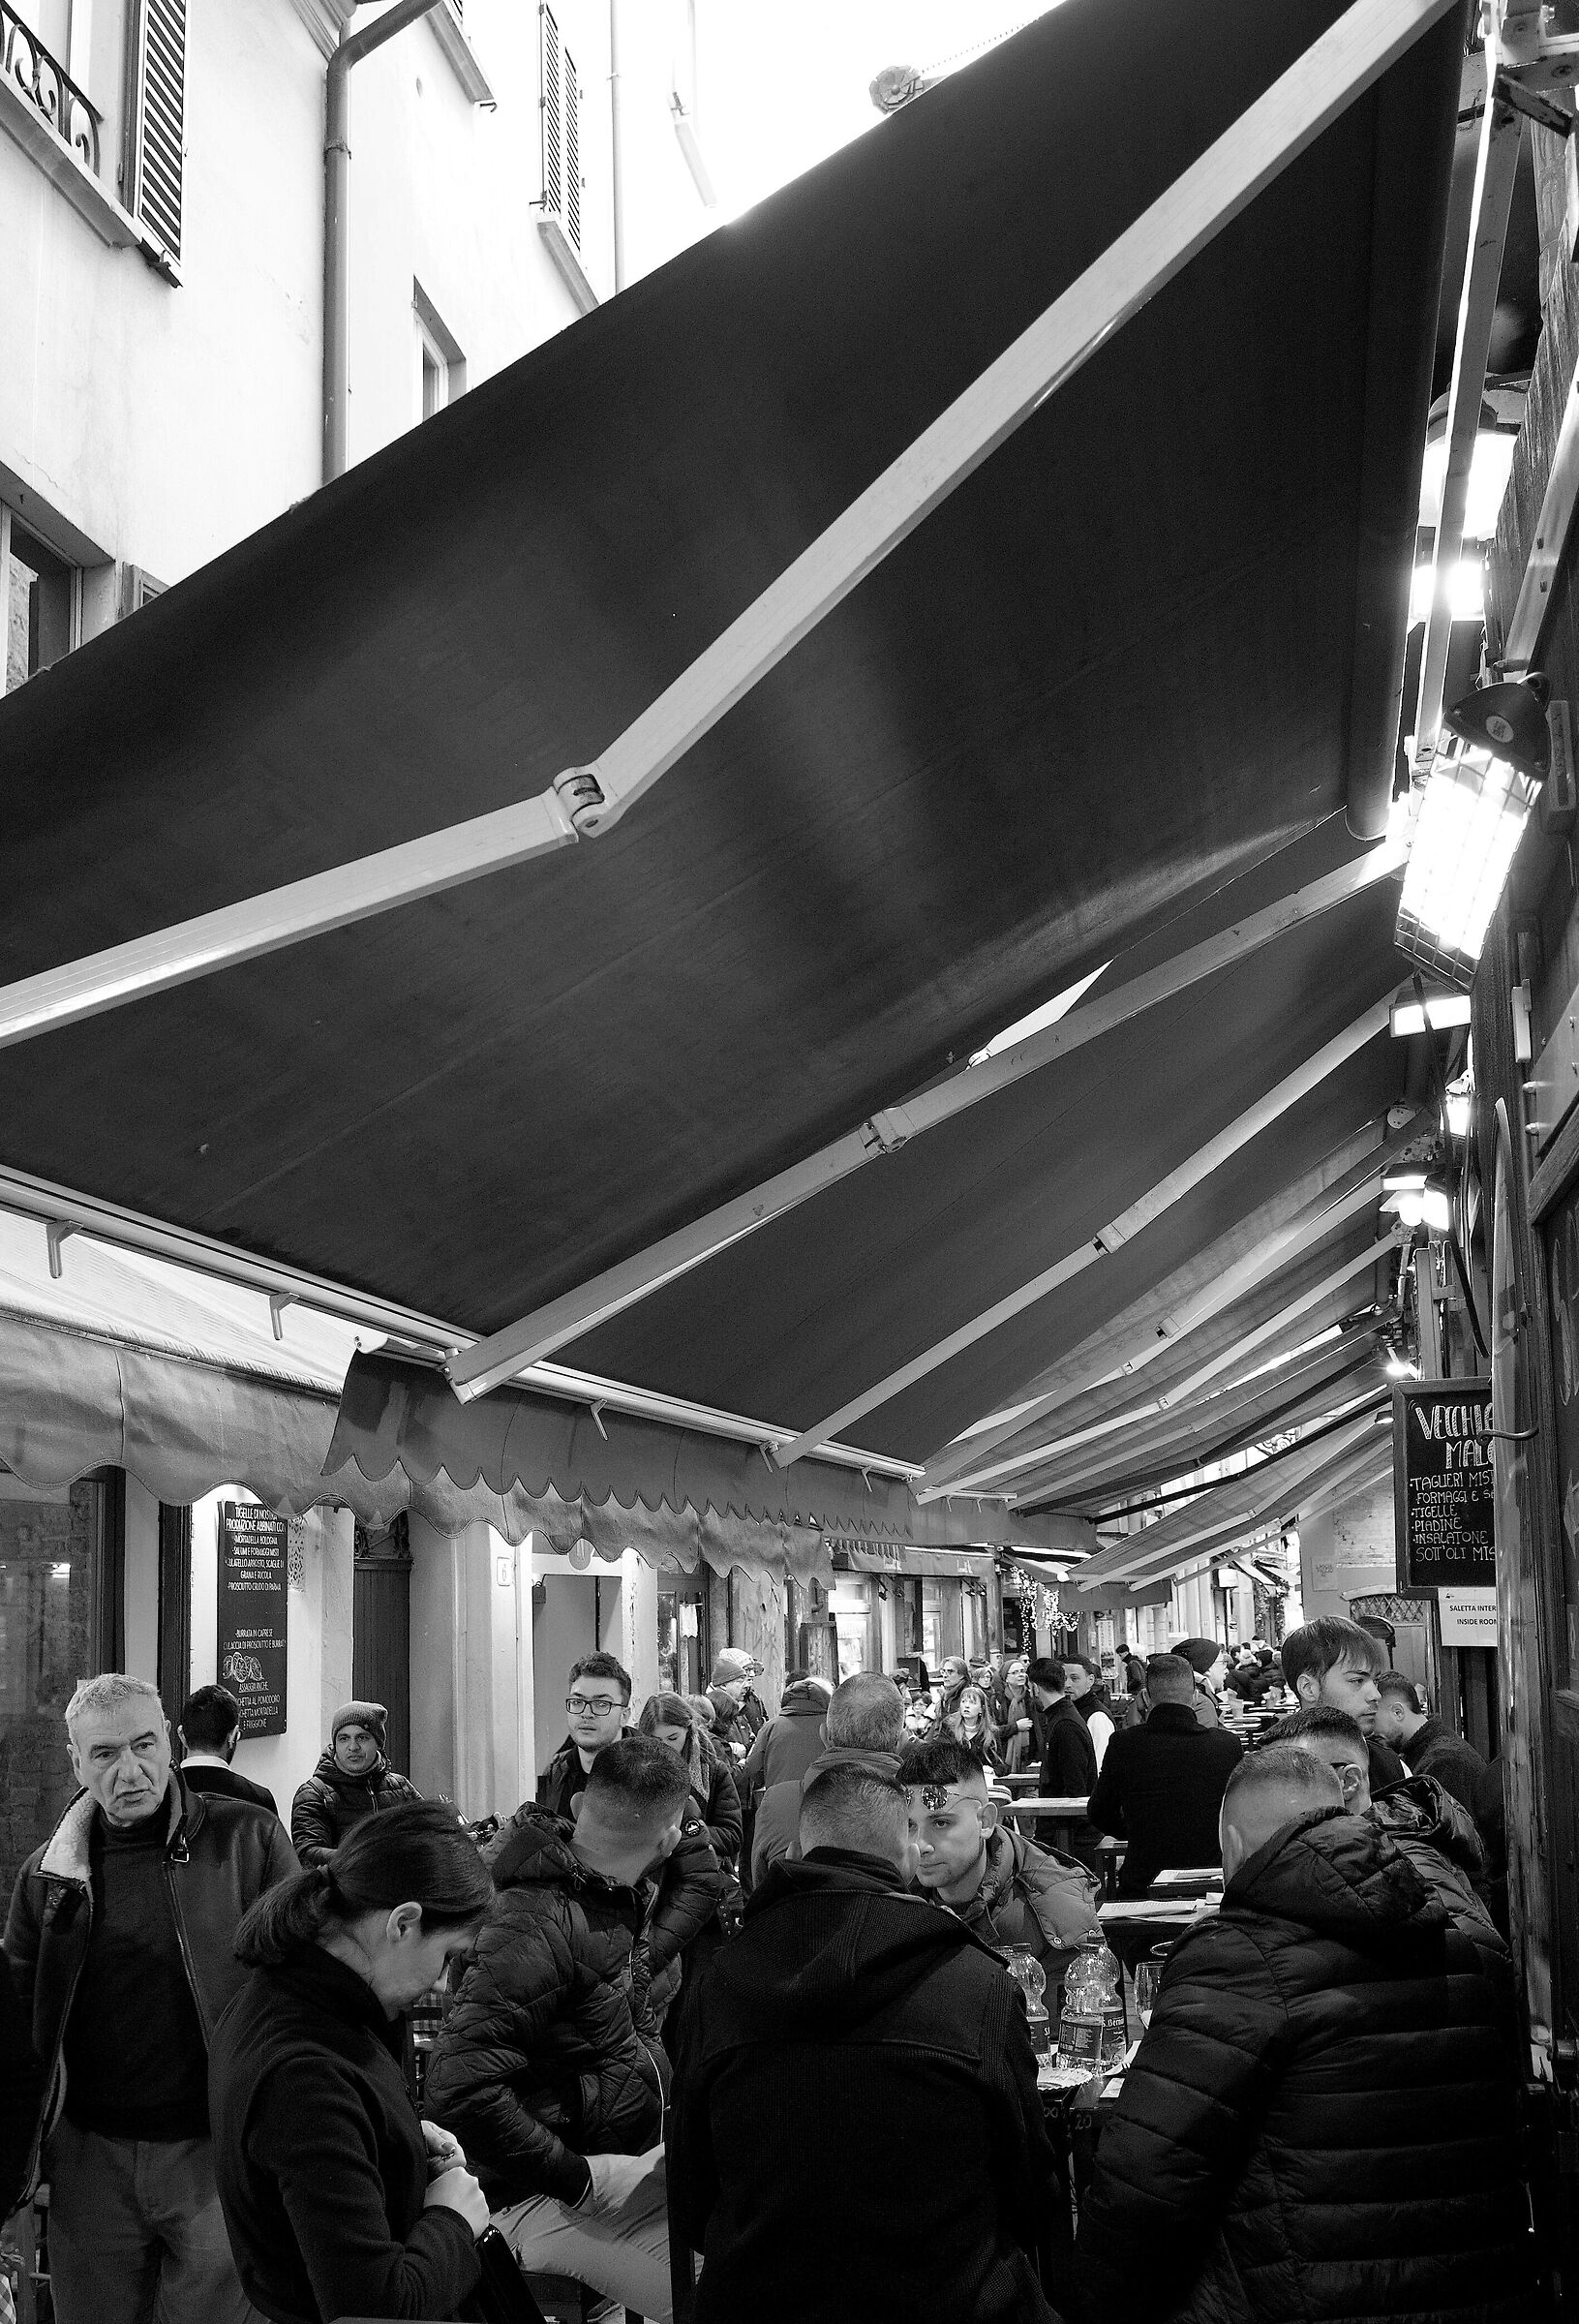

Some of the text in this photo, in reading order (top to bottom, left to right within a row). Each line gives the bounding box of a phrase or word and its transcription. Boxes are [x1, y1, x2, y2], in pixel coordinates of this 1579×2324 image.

[1472, 1490, 1479, 1502] E
[1412, 1504, 1457, 1518] TIGELLE
[1414, 1517, 1463, 1532] PIADINE
[1414, 1531, 1489, 1545] INSALATONE
[1473, 1545, 1496, 1562] MIS
